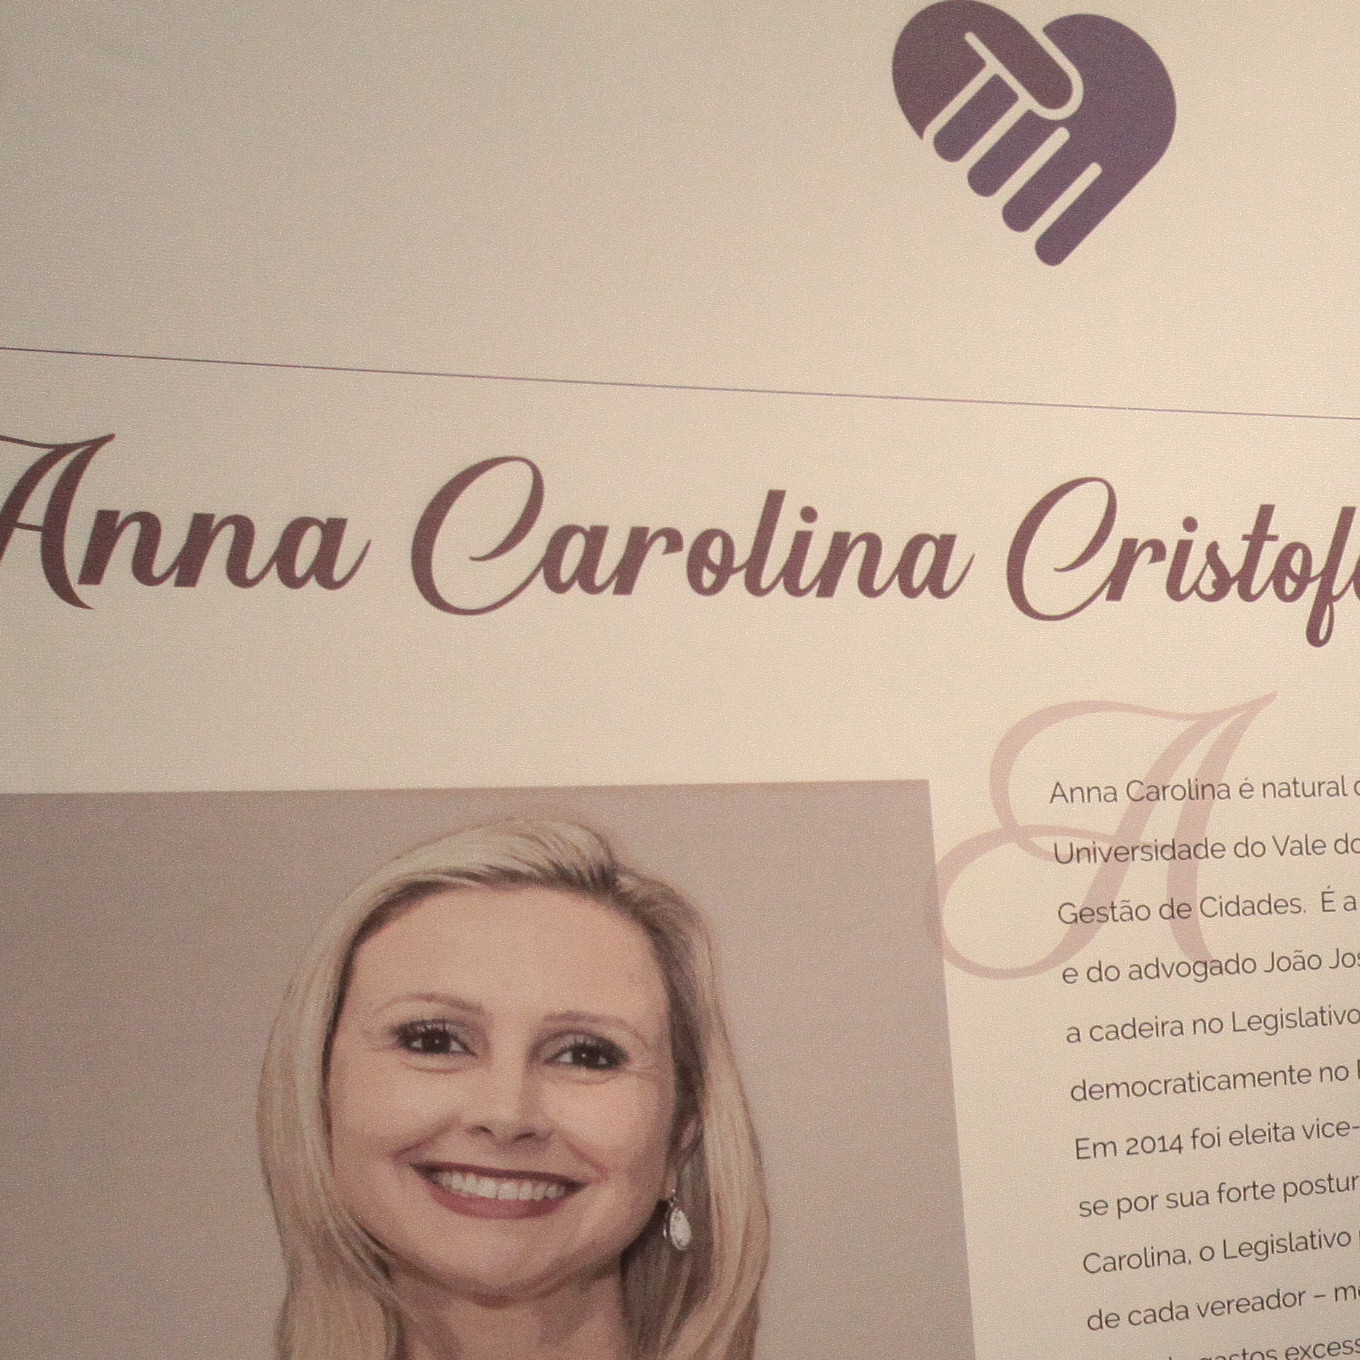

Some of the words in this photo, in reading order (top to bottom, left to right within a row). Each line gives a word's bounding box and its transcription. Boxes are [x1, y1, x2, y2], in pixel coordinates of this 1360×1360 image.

[0, 433, 372, 611] Anna
[411, 455, 976, 616] Carolina
[1049, 780, 1118, 803] Anna
[1125, 777, 1231, 803] Carolina
[1237, 777, 1254, 798] é
[1260, 774, 1348, 799] natural
[1056, 900, 1151, 925] Gestão
[1157, 896, 1192, 920] de
[1198, 892, 1307, 918] Cidades.
[1319, 886, 1336, 913] É
[1341, 893, 1358, 912] a
[1065, 1025, 1081, 1044] a
[1087, 1015, 1185, 1043] cadeira
[1191, 1015, 1225, 1036] no
[1073, 1135, 1118, 1161] Em
[1124, 1133, 1184, 1157] 2014
[1189, 1125, 1222, 1150] foi
[1227, 1120, 1296, 1147] eleita
[1081, 1245, 1192, 1275] Carolina,
[1197, 1243, 1216, 1263] o
[1221, 1229, 1352, 1263] Legislativo
